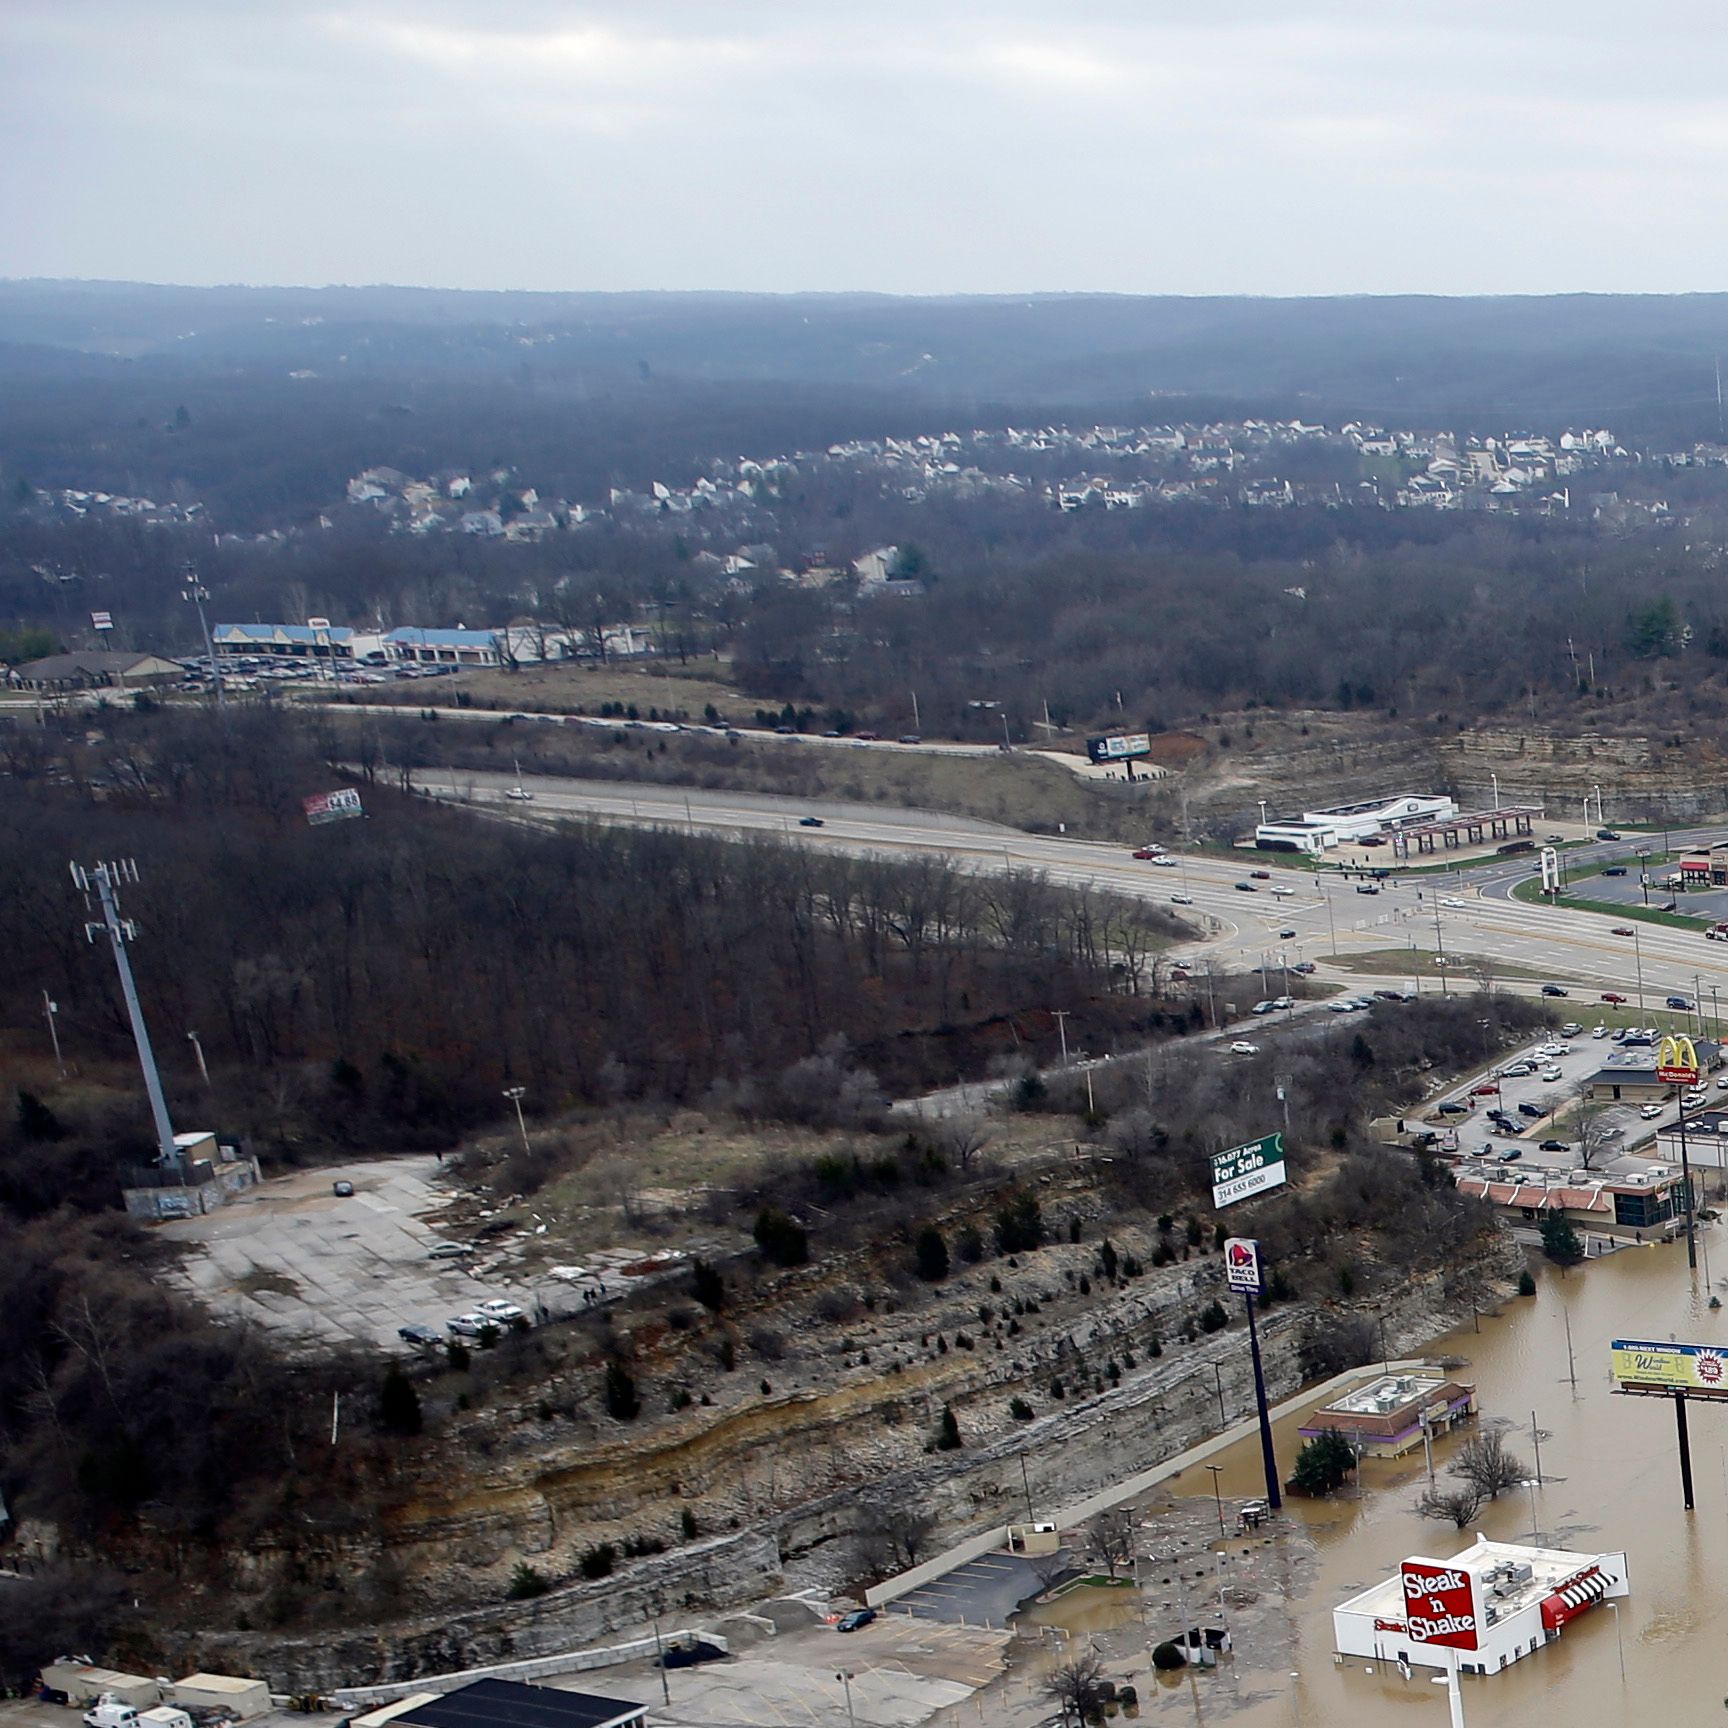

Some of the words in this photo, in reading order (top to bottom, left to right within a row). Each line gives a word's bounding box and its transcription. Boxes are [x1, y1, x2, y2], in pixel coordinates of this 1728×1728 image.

[1658, 1071, 1697, 1079] McDonald's
[1214, 1167, 1235, 1183] For
[1237, 1154, 1263, 1173] Sale
[1403, 1570, 1465, 1598] Steak
[1408, 1613, 1476, 1641] Shake
